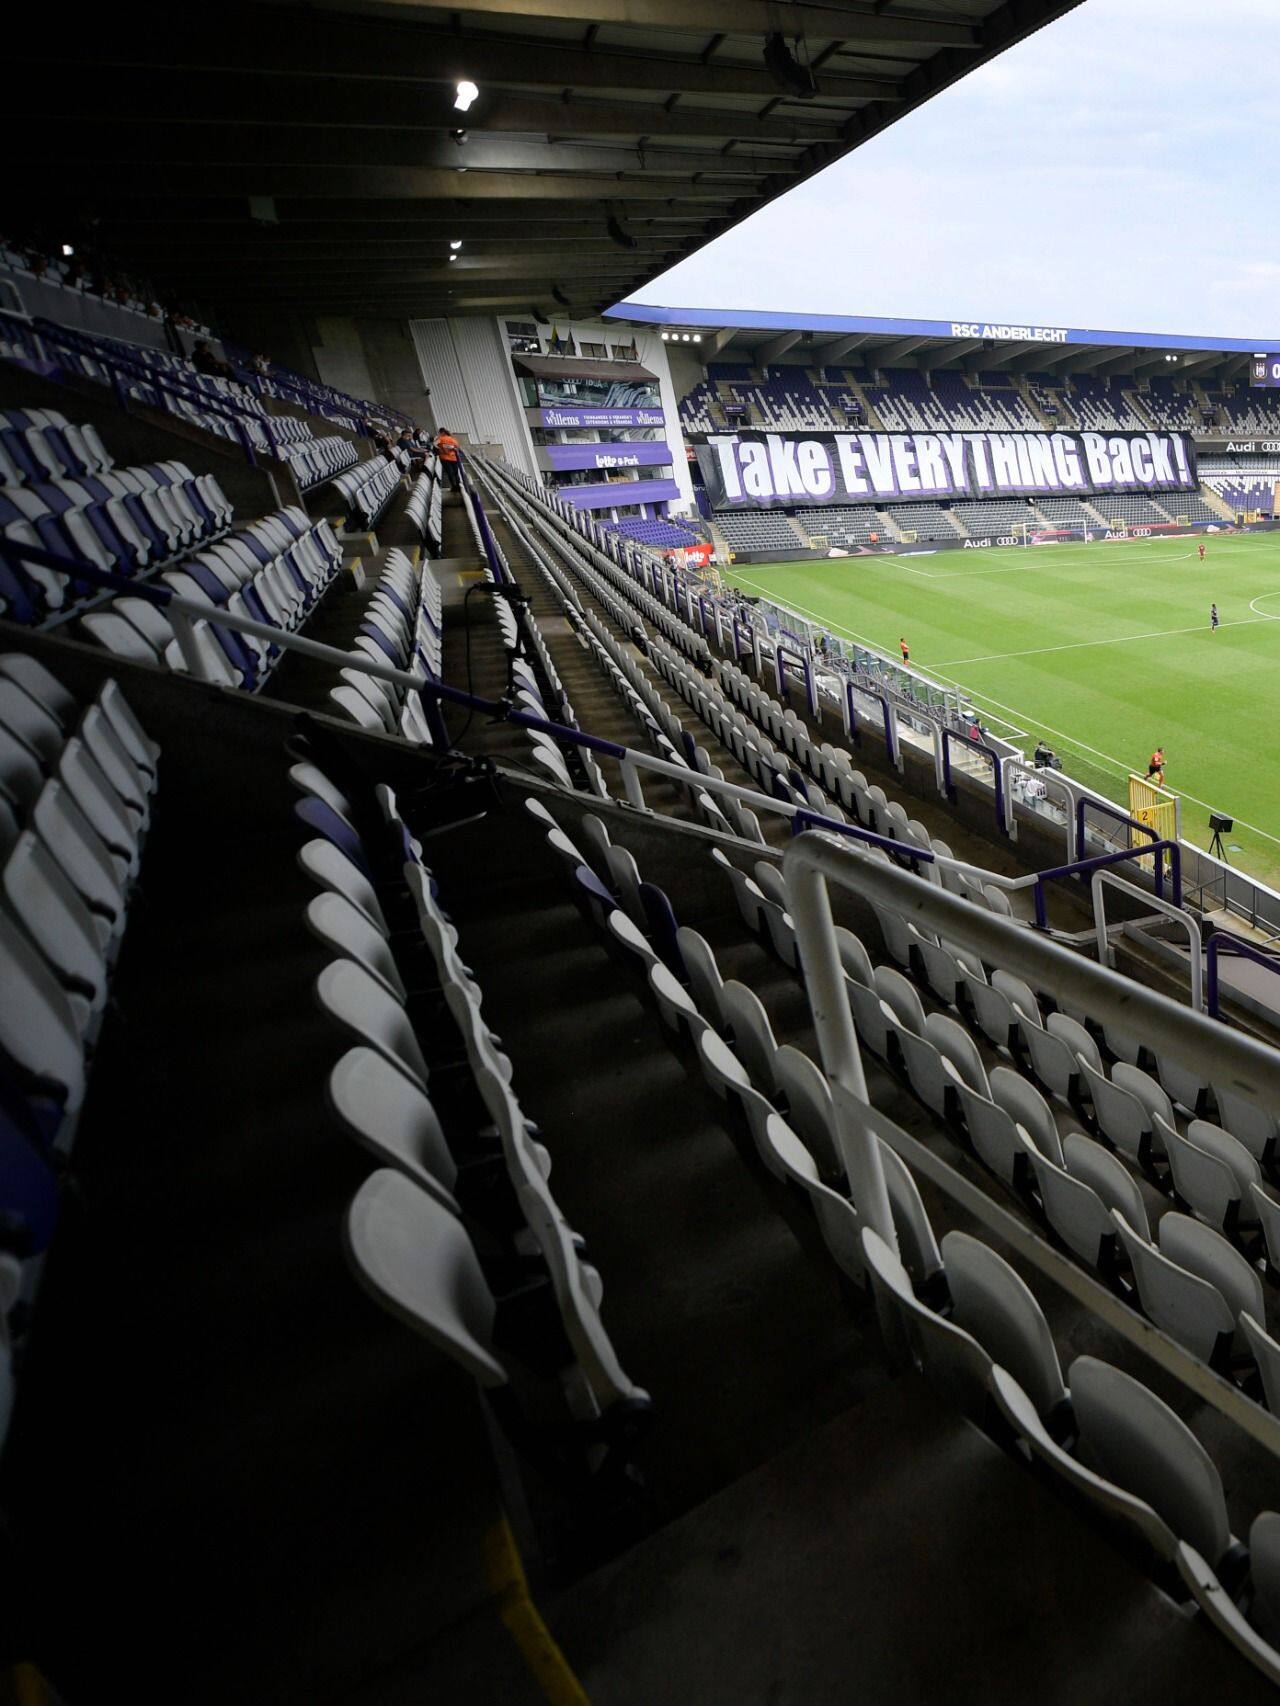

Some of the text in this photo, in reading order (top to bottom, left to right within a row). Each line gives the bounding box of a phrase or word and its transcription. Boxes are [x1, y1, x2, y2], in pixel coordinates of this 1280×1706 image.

[951, 323, 1068, 342] RSC ANDERLECHT
[546, 410, 580, 426] willems
[636, 410, 663, 424] willems
[1226, 442, 1256, 452] Audi
[595, 455, 617, 468] lotto
[707, 434, 831, 499] Take
[834, 432, 1082, 494] EVERYTHING
[1104, 529, 1128, 539] Audi
[964, 538, 991, 549] Audi
[685, 550, 704, 562] lotto
[1142, 812, 1148, 820] 2
